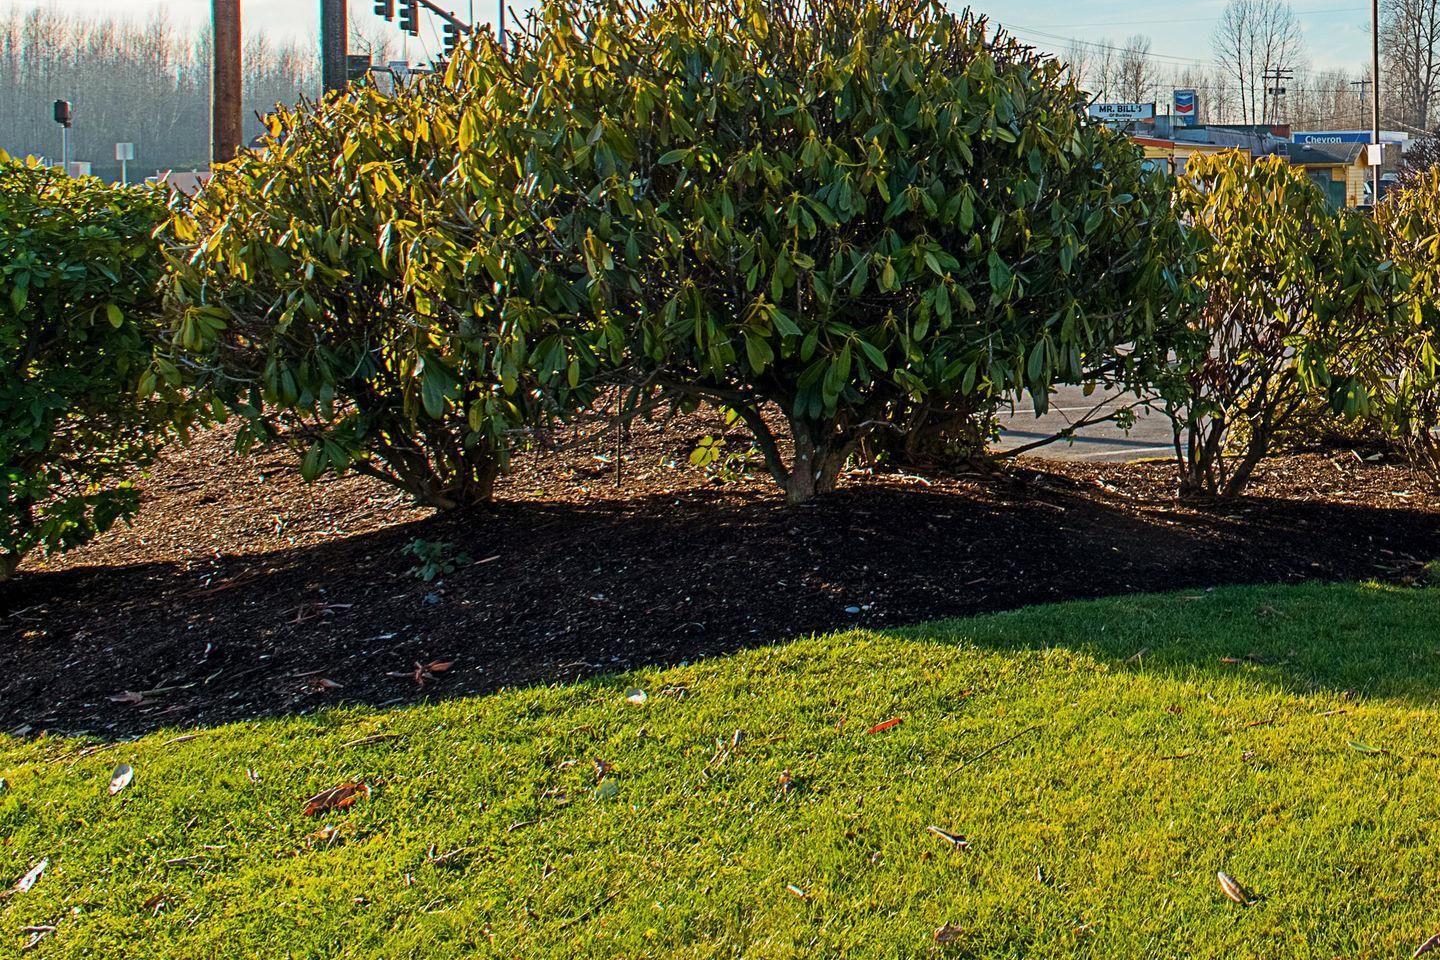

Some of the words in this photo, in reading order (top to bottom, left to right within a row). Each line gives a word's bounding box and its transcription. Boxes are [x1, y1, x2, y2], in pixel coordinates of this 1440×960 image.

[1098, 105, 1115, 113] MR.
[1117, 105, 1142, 113] BILL'S
[1305, 135, 1342, 144] Chevron
